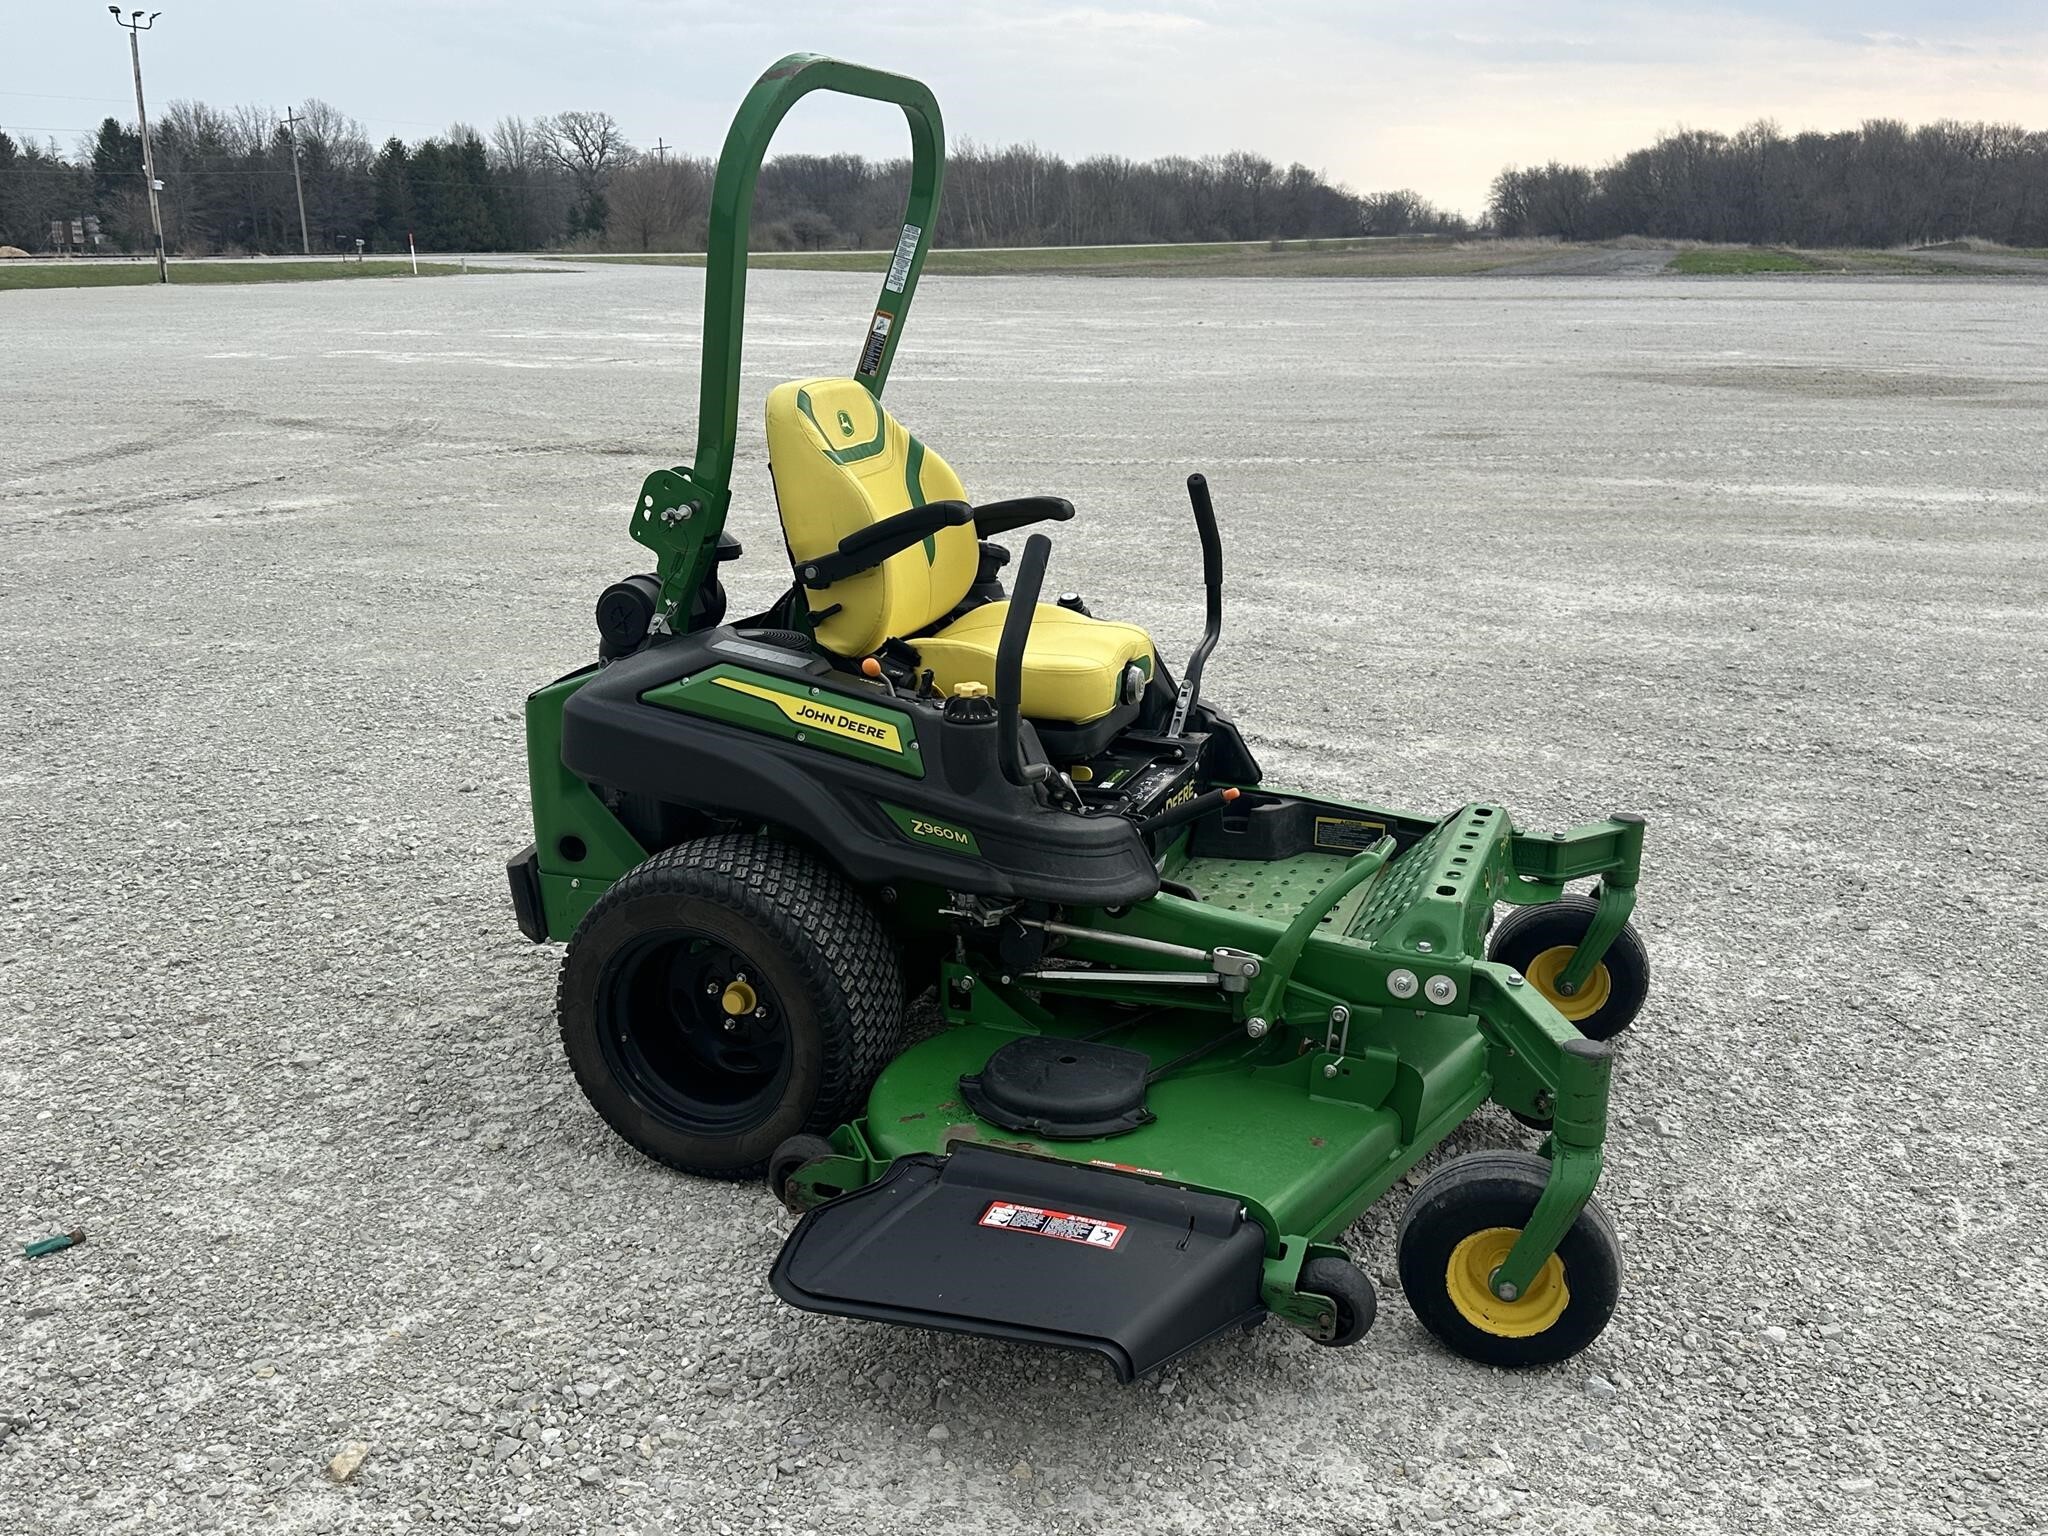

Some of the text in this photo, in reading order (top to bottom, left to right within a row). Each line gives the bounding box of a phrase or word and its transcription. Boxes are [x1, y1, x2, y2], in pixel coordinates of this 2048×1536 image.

[796, 705, 887, 740] JOHN DEERE
[911, 819, 968, 844] Z960M
